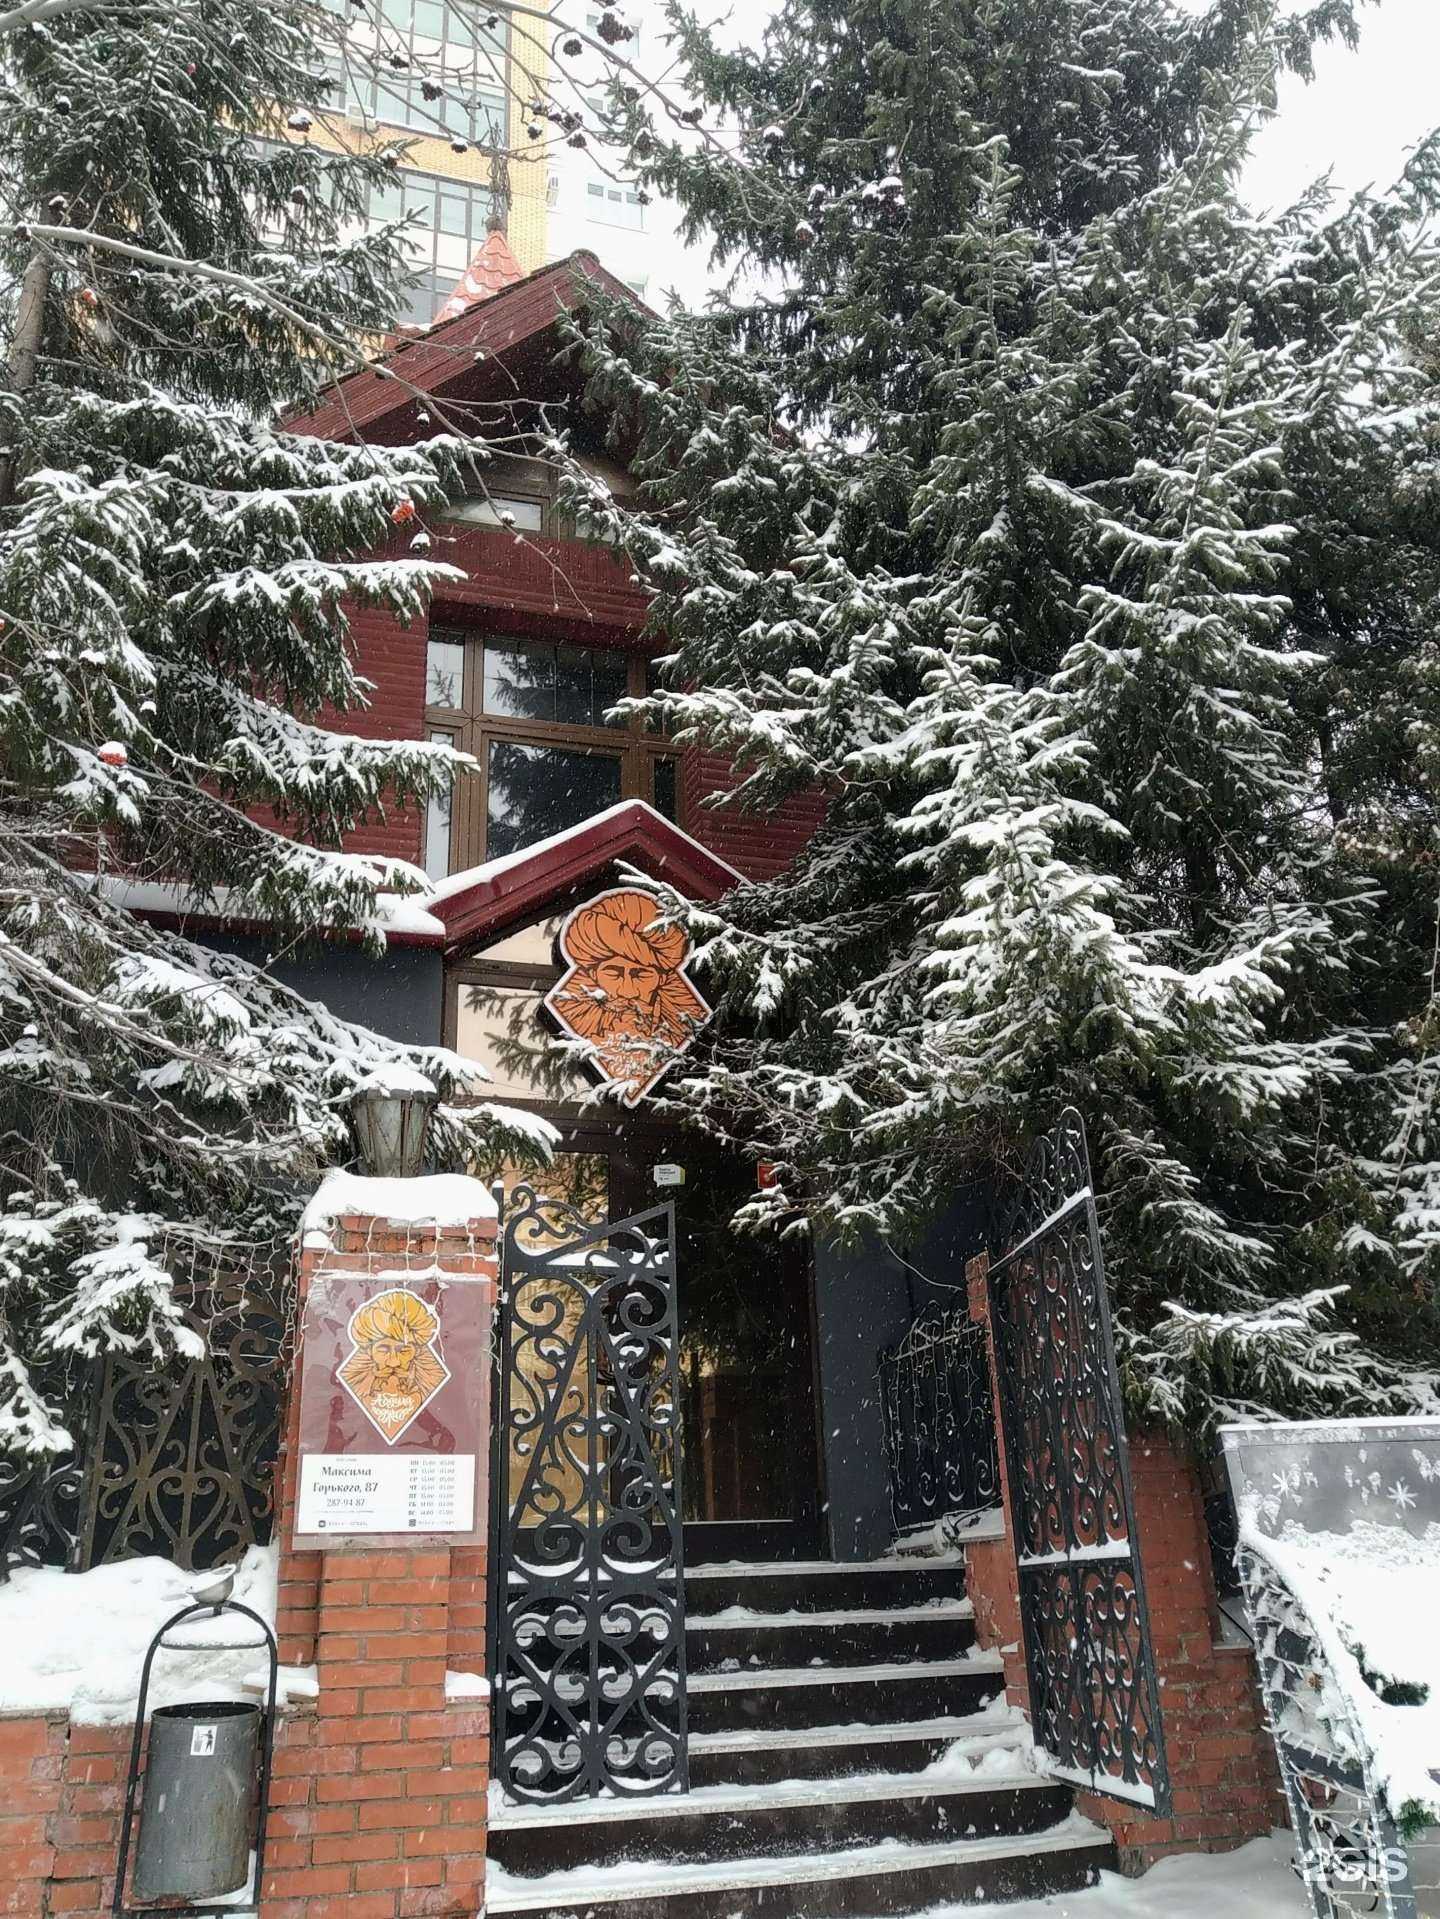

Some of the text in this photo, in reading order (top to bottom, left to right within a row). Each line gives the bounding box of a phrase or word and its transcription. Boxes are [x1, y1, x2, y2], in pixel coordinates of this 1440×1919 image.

[321, 1466, 372, 1477] Максима
[313, 1482, 379, 1494] Горького, 87
